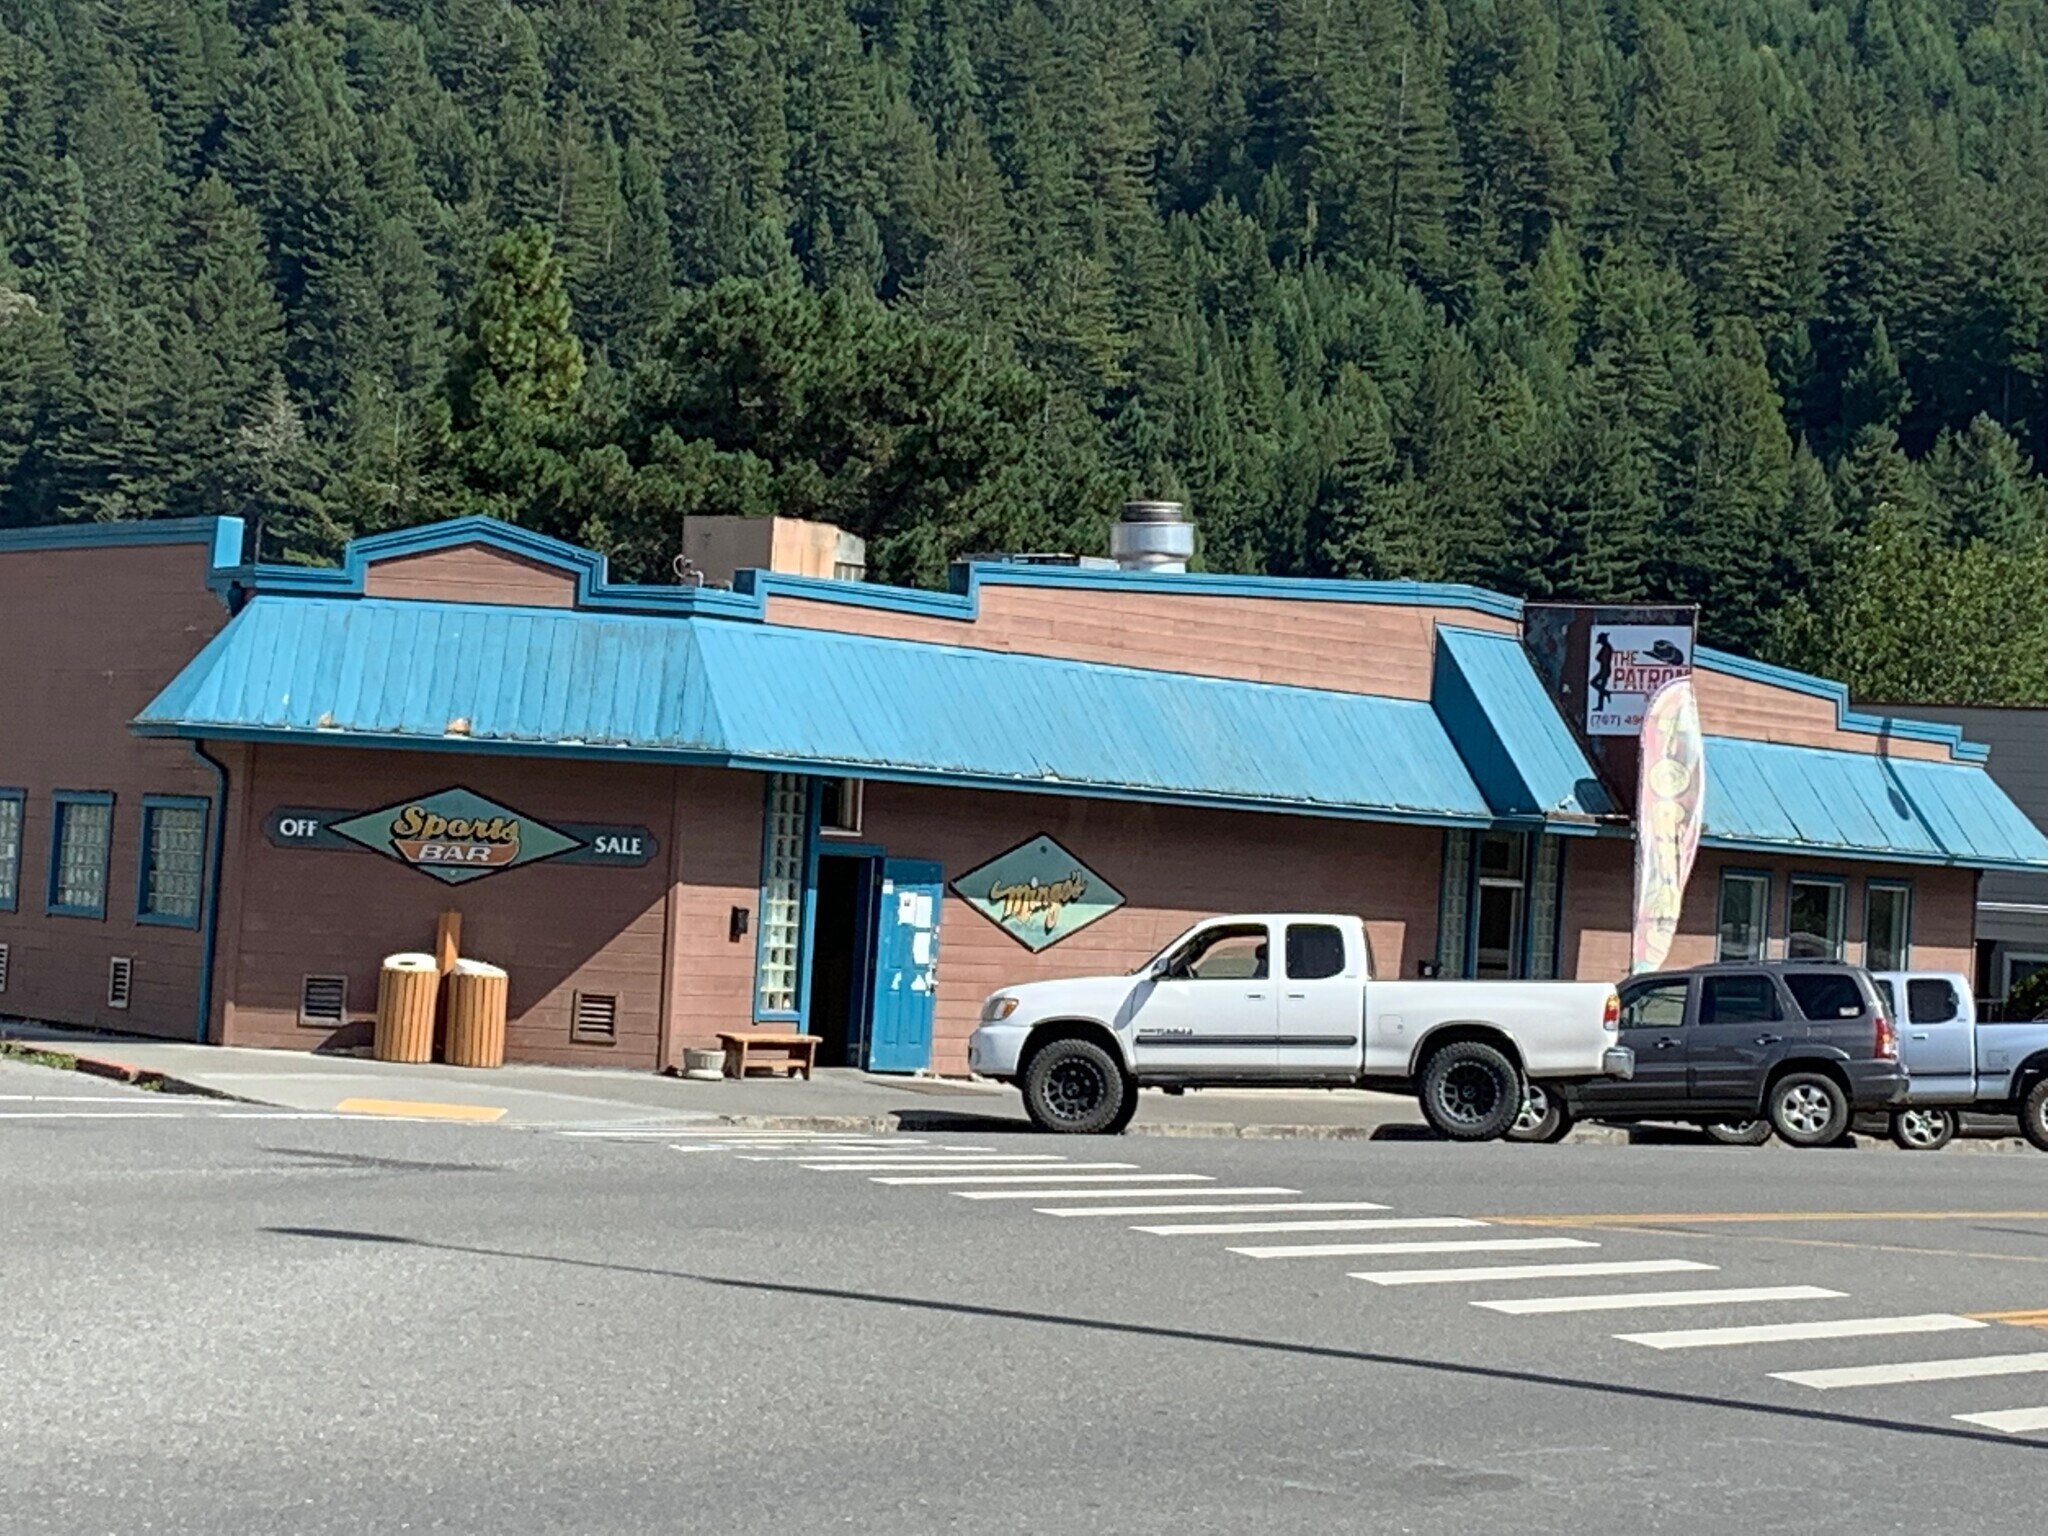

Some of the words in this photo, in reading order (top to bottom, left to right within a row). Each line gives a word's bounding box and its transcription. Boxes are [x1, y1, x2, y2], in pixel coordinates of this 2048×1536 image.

[1613, 650, 1638, 666] THE
[279, 818, 319, 837] OFF
[594, 836, 642, 855] SALE
[393, 805, 519, 841] Sports
[418, 843, 492, 862] BAR
